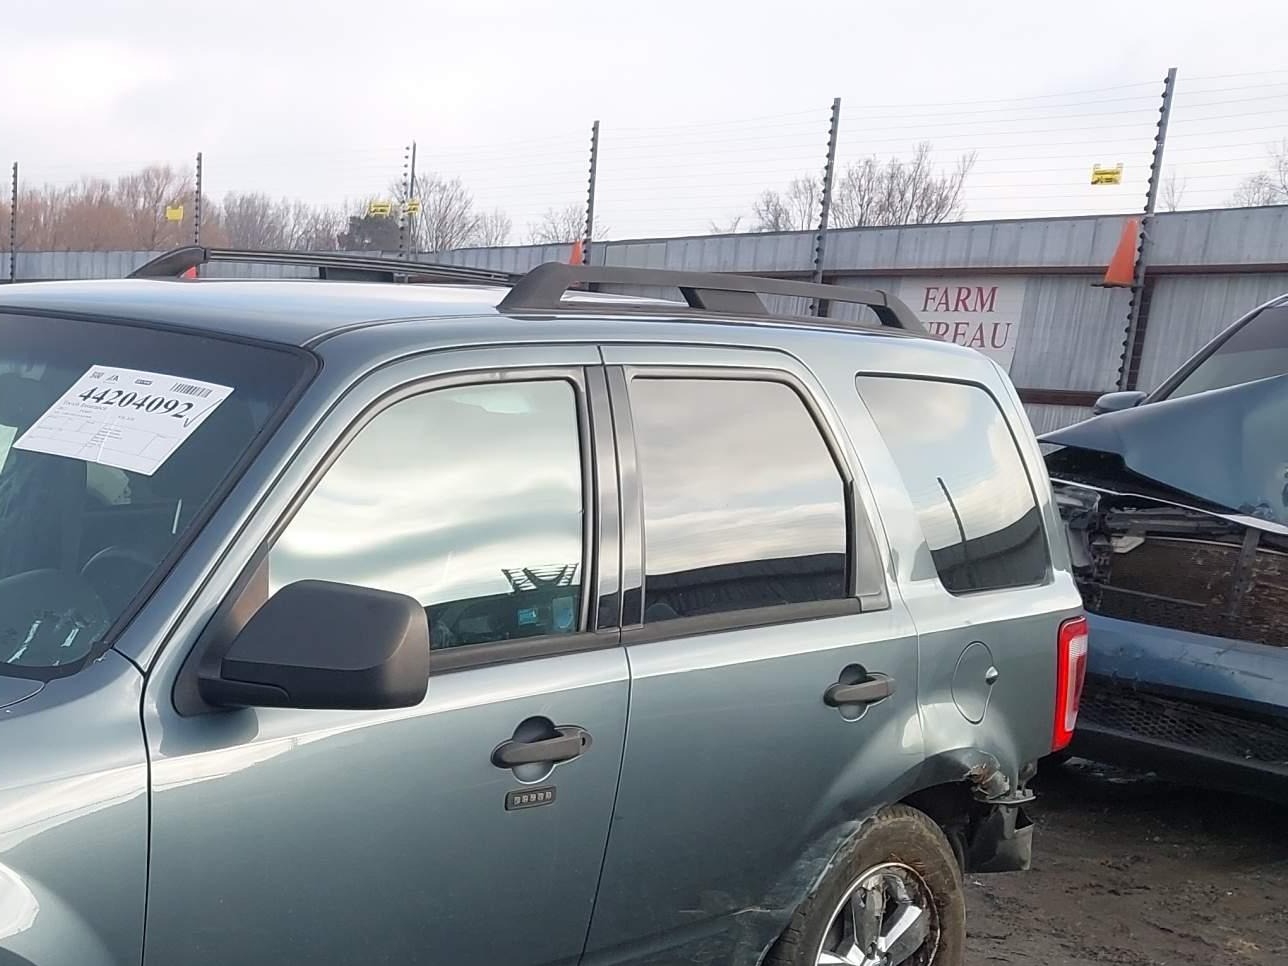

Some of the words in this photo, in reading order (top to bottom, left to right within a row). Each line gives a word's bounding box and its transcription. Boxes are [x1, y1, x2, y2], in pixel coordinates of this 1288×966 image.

[920, 285, 999, 313] FARM
[926, 320, 1013, 349] REAU
[78, 386, 194, 418] 44204092
